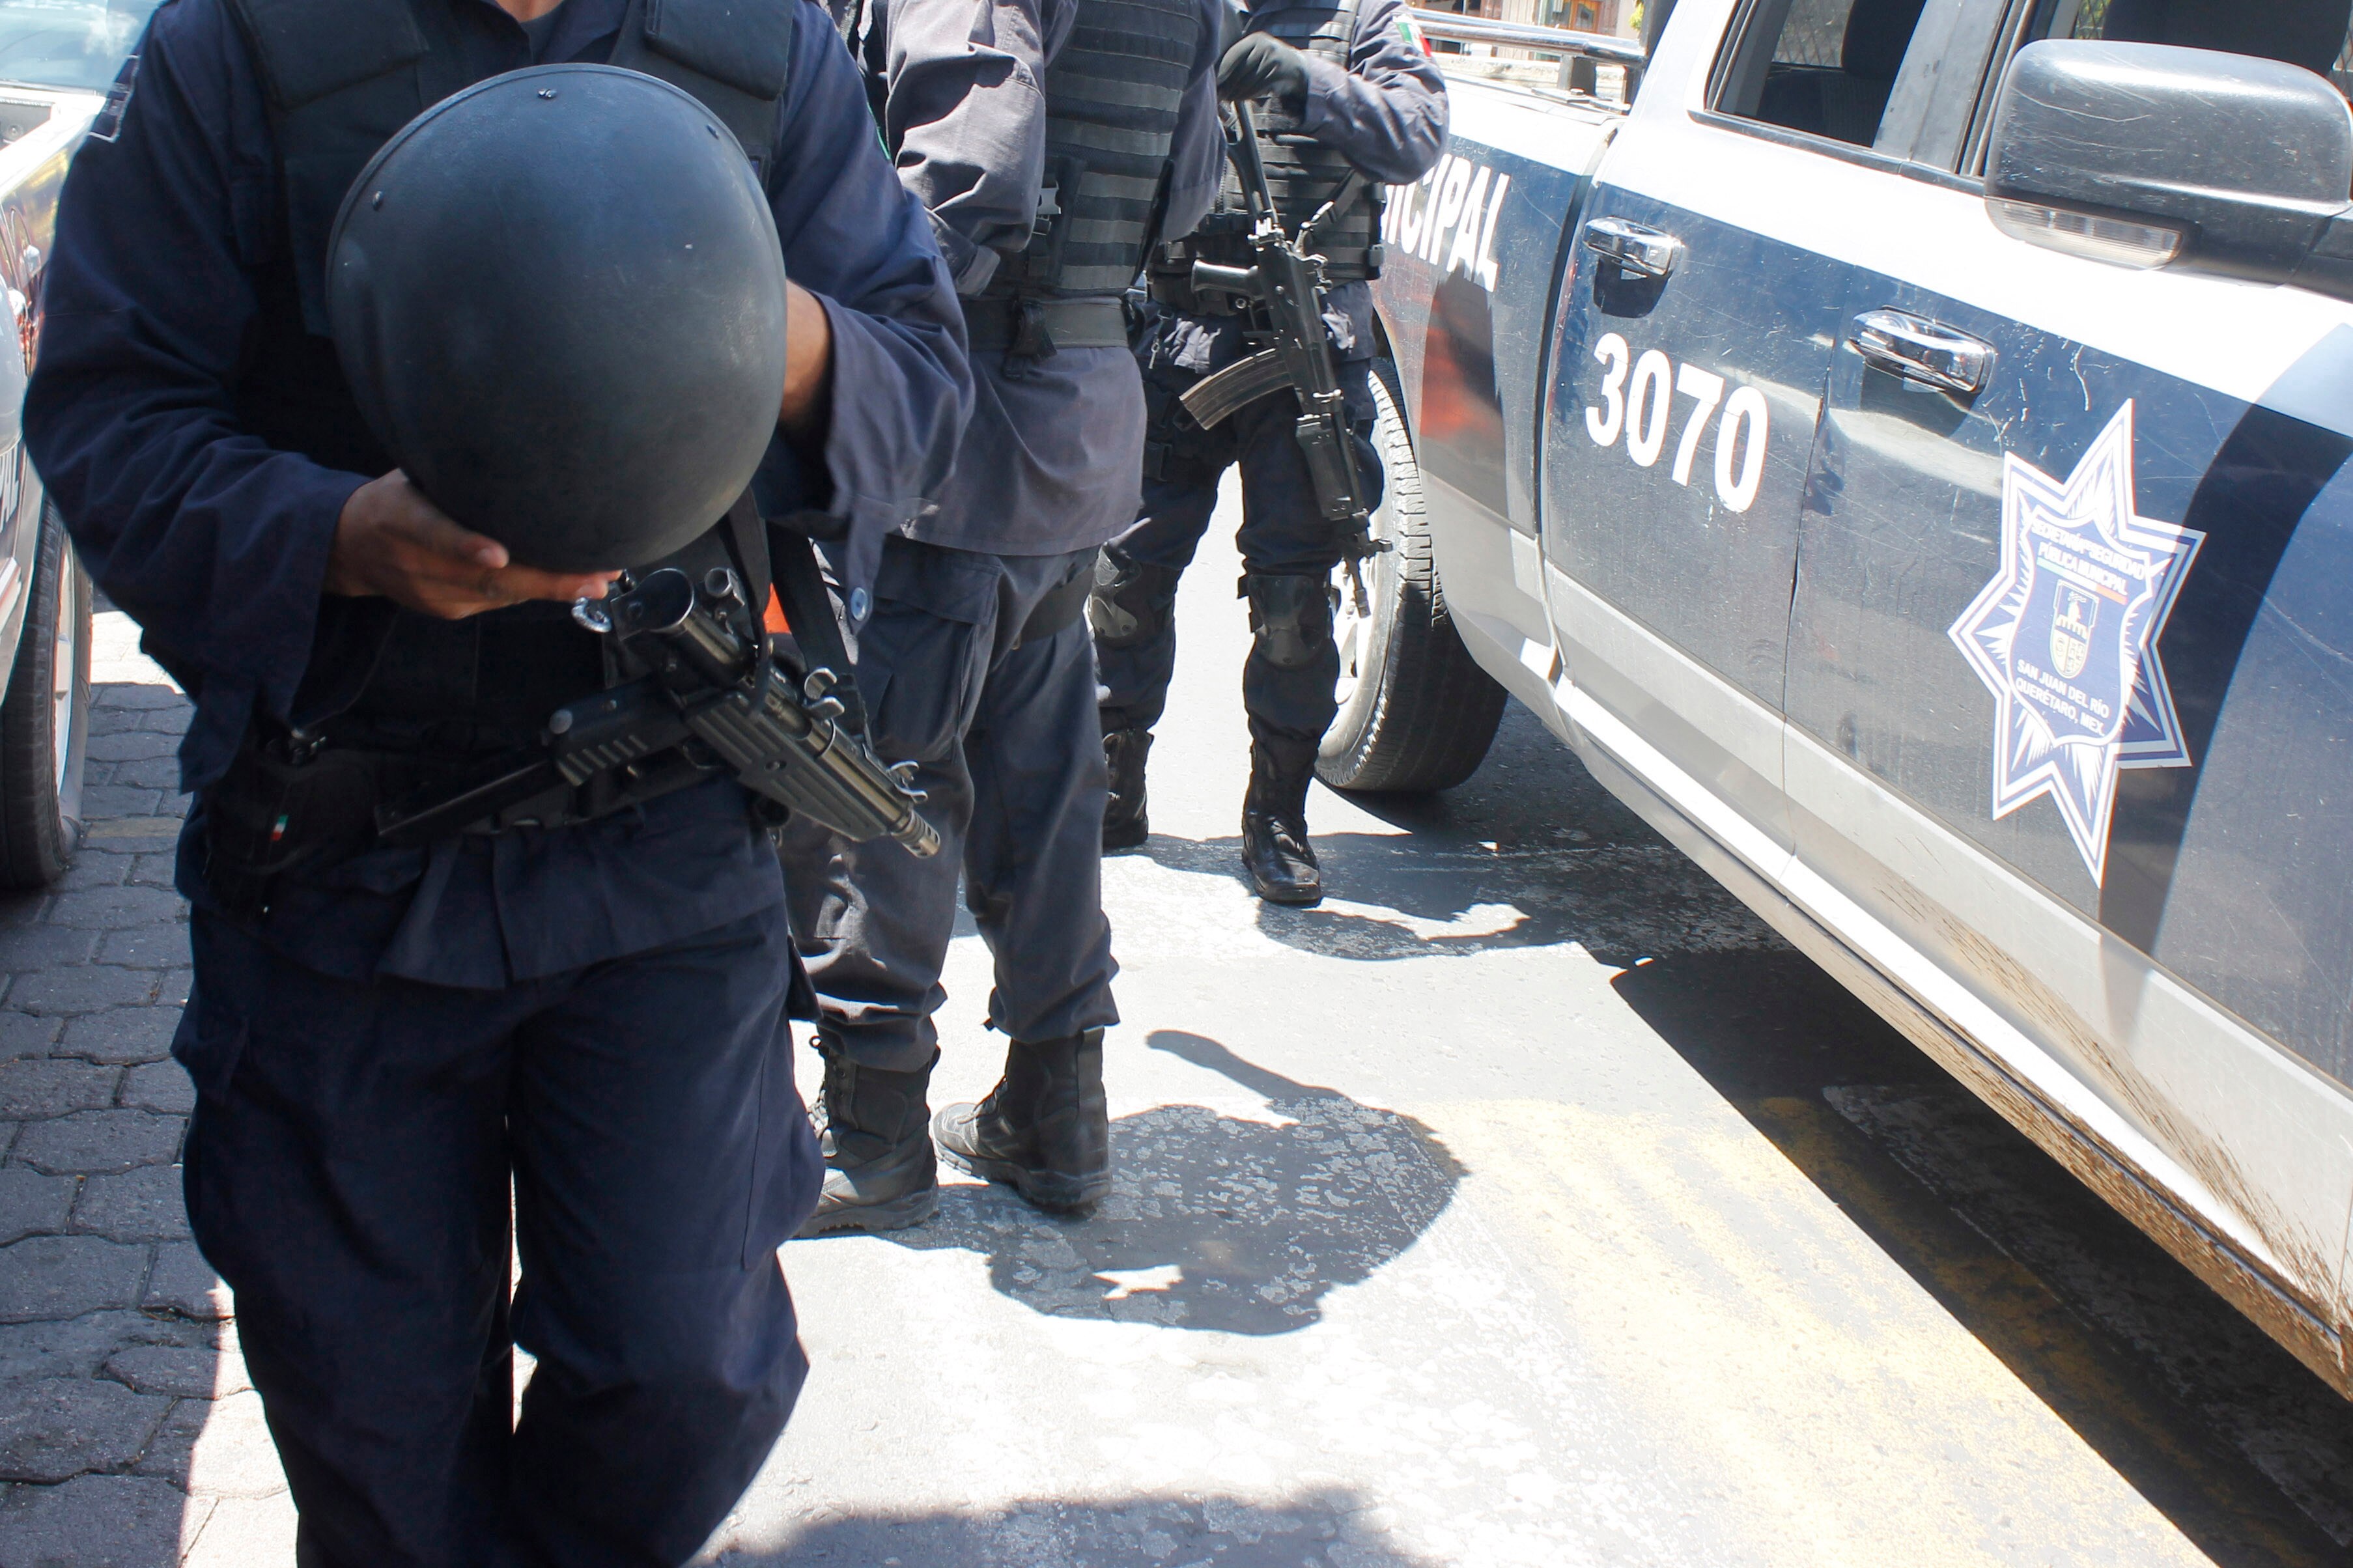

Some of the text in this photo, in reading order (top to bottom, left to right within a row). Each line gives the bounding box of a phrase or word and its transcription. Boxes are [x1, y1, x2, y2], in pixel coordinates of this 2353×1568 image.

[1585, 332, 1769, 514] 3070
[2016, 677, 2078, 724] QUERÉTARO,
[2017, 658, 2110, 719] SAN JUAN DEL RÍO
